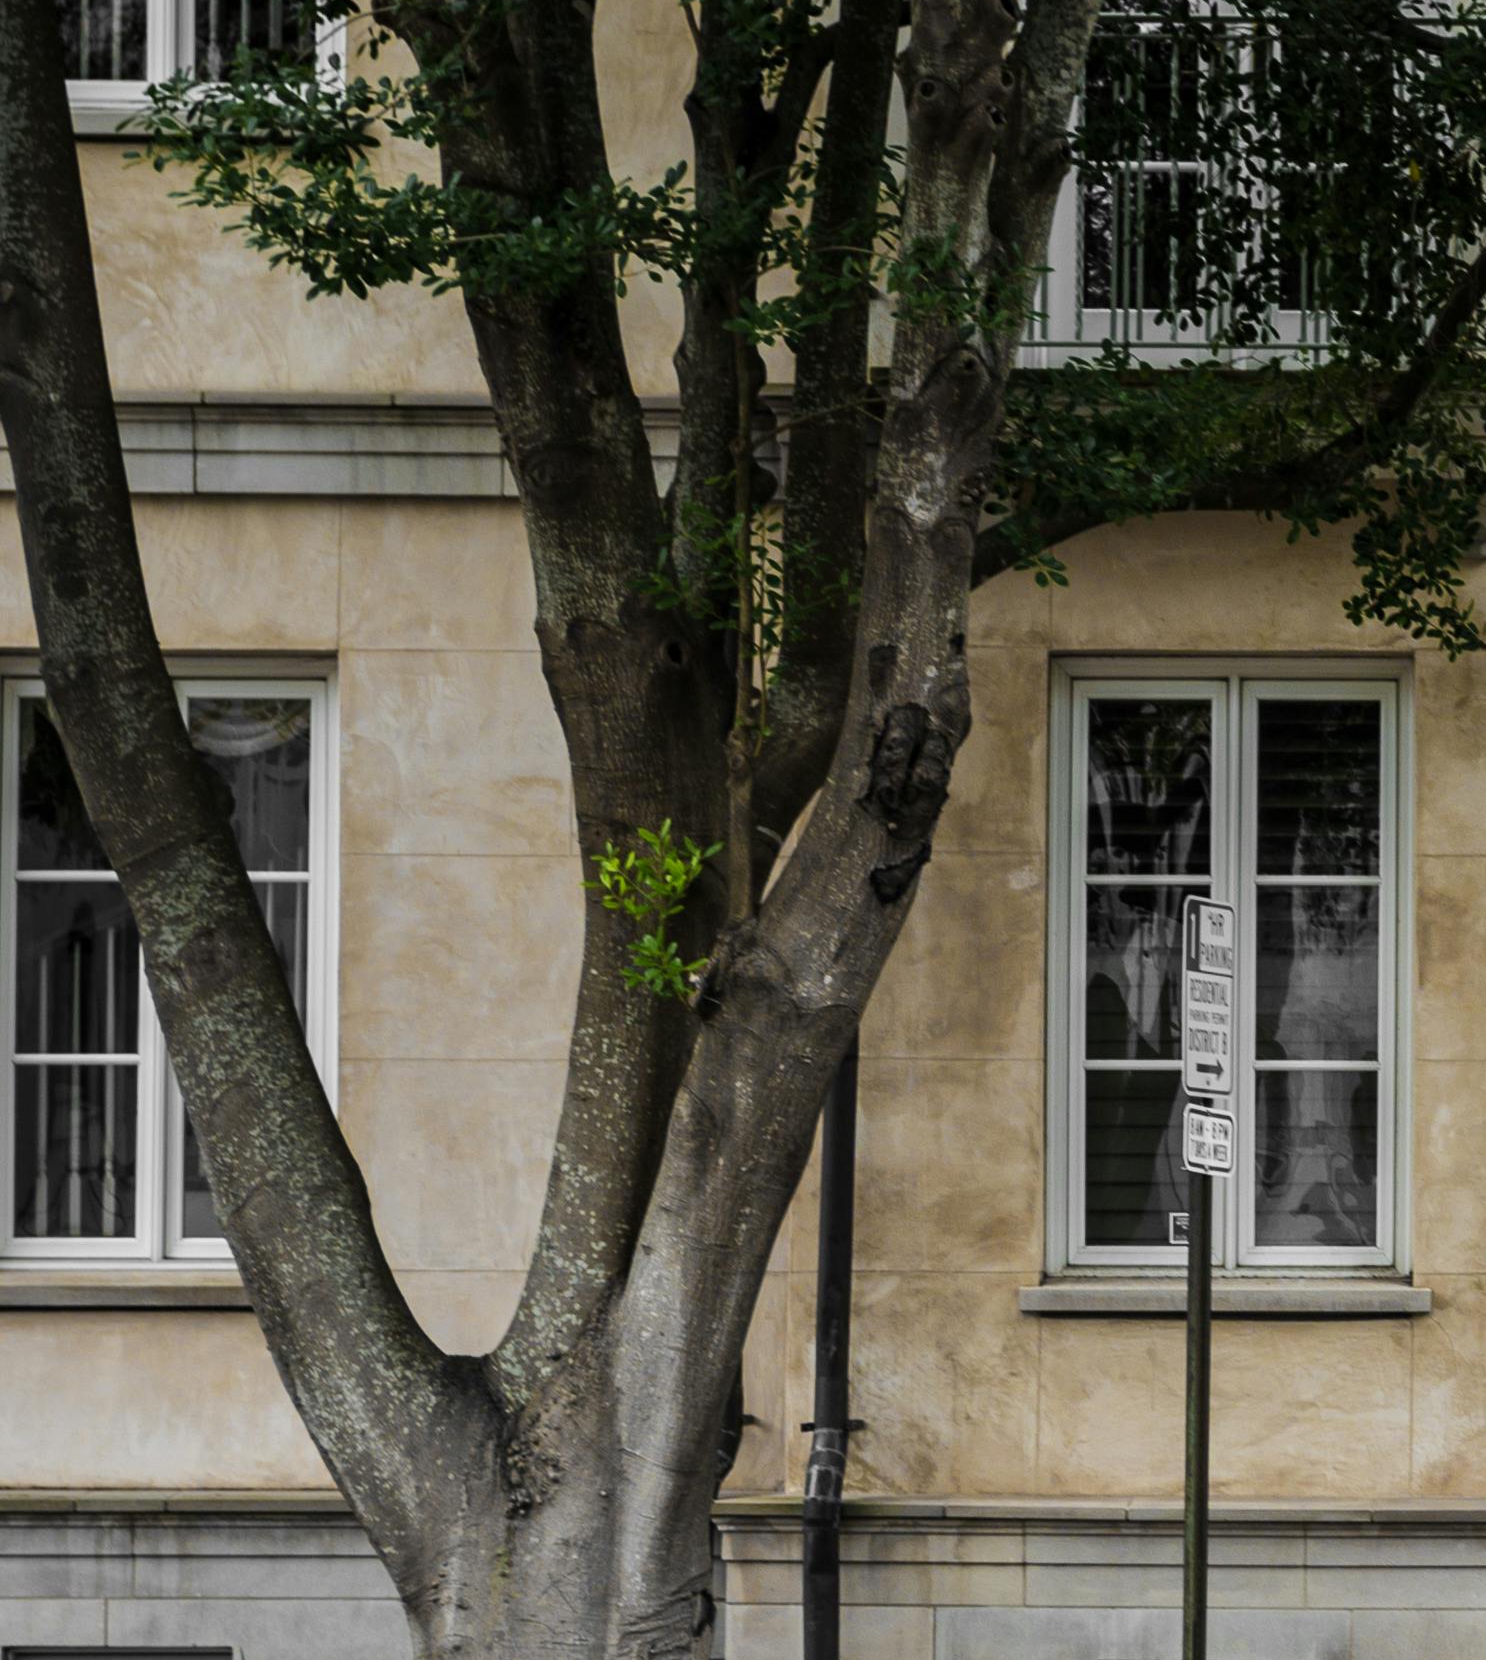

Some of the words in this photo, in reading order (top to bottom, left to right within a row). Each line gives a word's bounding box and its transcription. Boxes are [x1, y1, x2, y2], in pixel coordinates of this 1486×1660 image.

[1199, 942, 1232, 970] PARKING
[1190, 979, 1229, 1007] RESIDENTIAL
[1189, 1010, 1210, 1023] PARKING
[1212, 1013, 1229, 1026] PERMIT
[1188, 1028, 1219, 1054] DISTRICT
[1218, 1123, 1228, 1142] PM
[1213, 1144, 1227, 1163] WEEK
